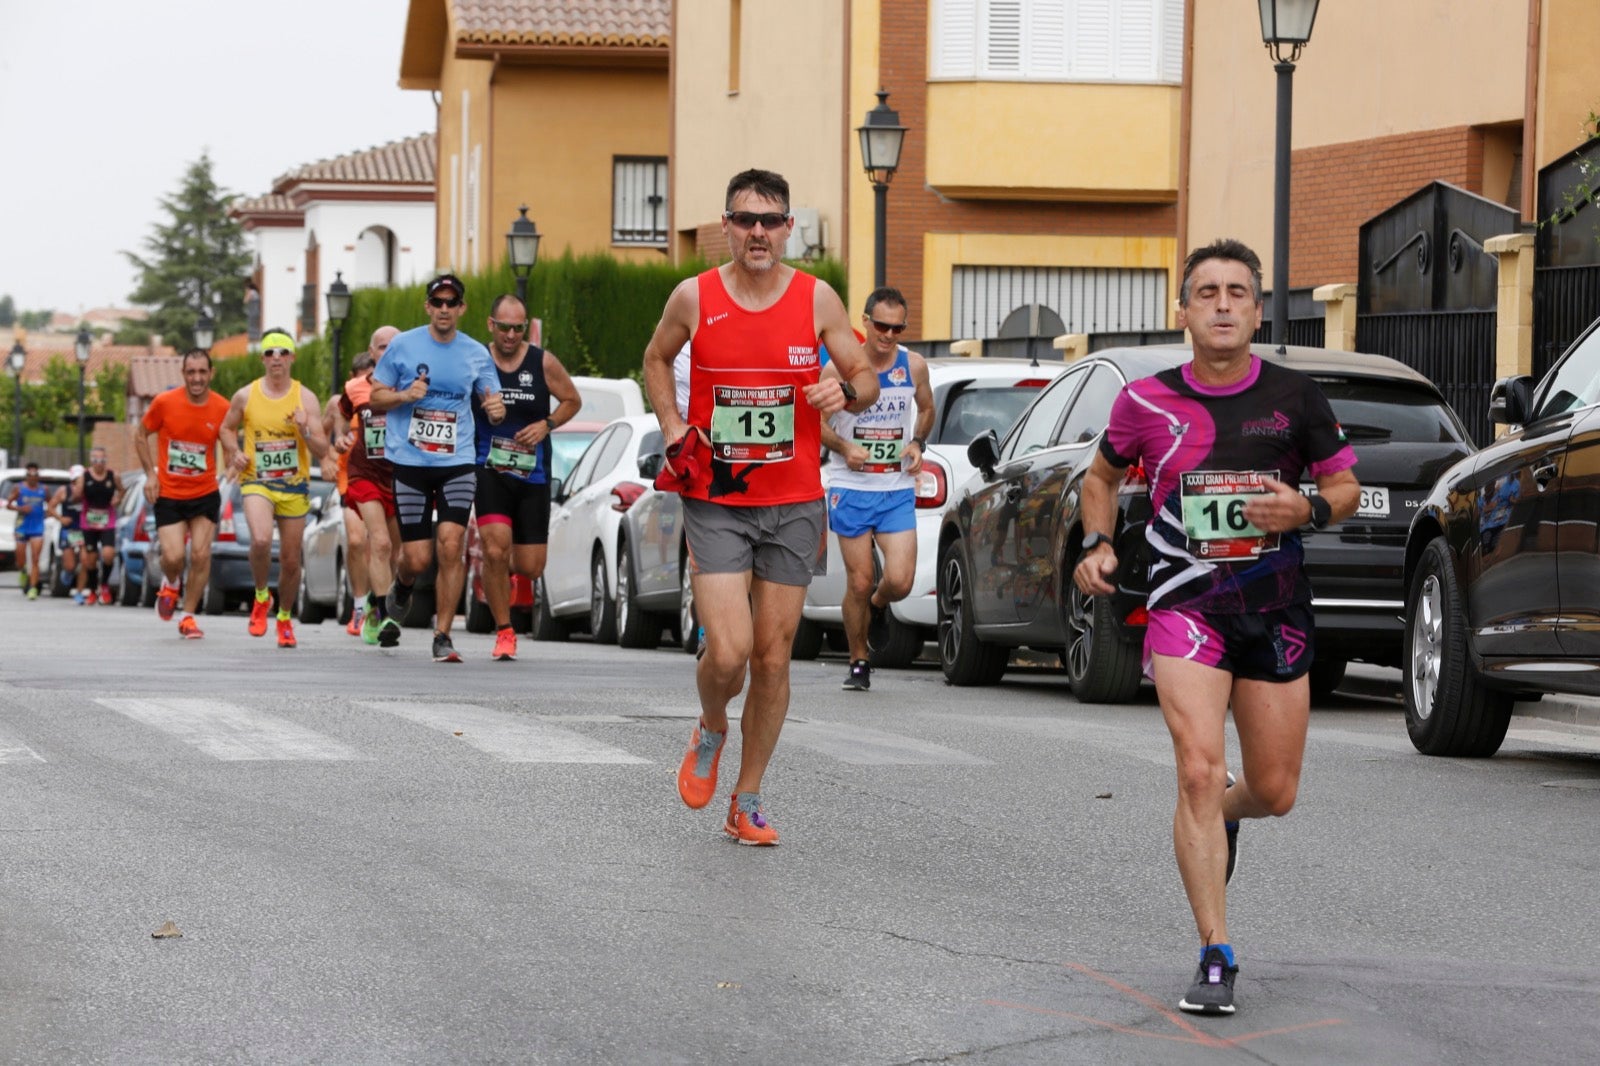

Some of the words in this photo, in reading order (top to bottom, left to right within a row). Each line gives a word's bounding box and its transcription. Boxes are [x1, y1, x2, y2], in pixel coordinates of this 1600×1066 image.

[732, 389, 747, 399] GRAN
[748, 389, 768, 399] PREMIO
[769, 389, 776, 399] DE
[415, 421, 453, 439] 3073
[738, 410, 776, 438] 13
[262, 451, 292, 468] 946
[861, 442, 896, 460] 752
[507, 453, 519, 467] 5
[1205, 474, 1224, 484] GRAN
[1225, 473, 1249, 484] PREMIO
[1202, 499, 1249, 531] 16
